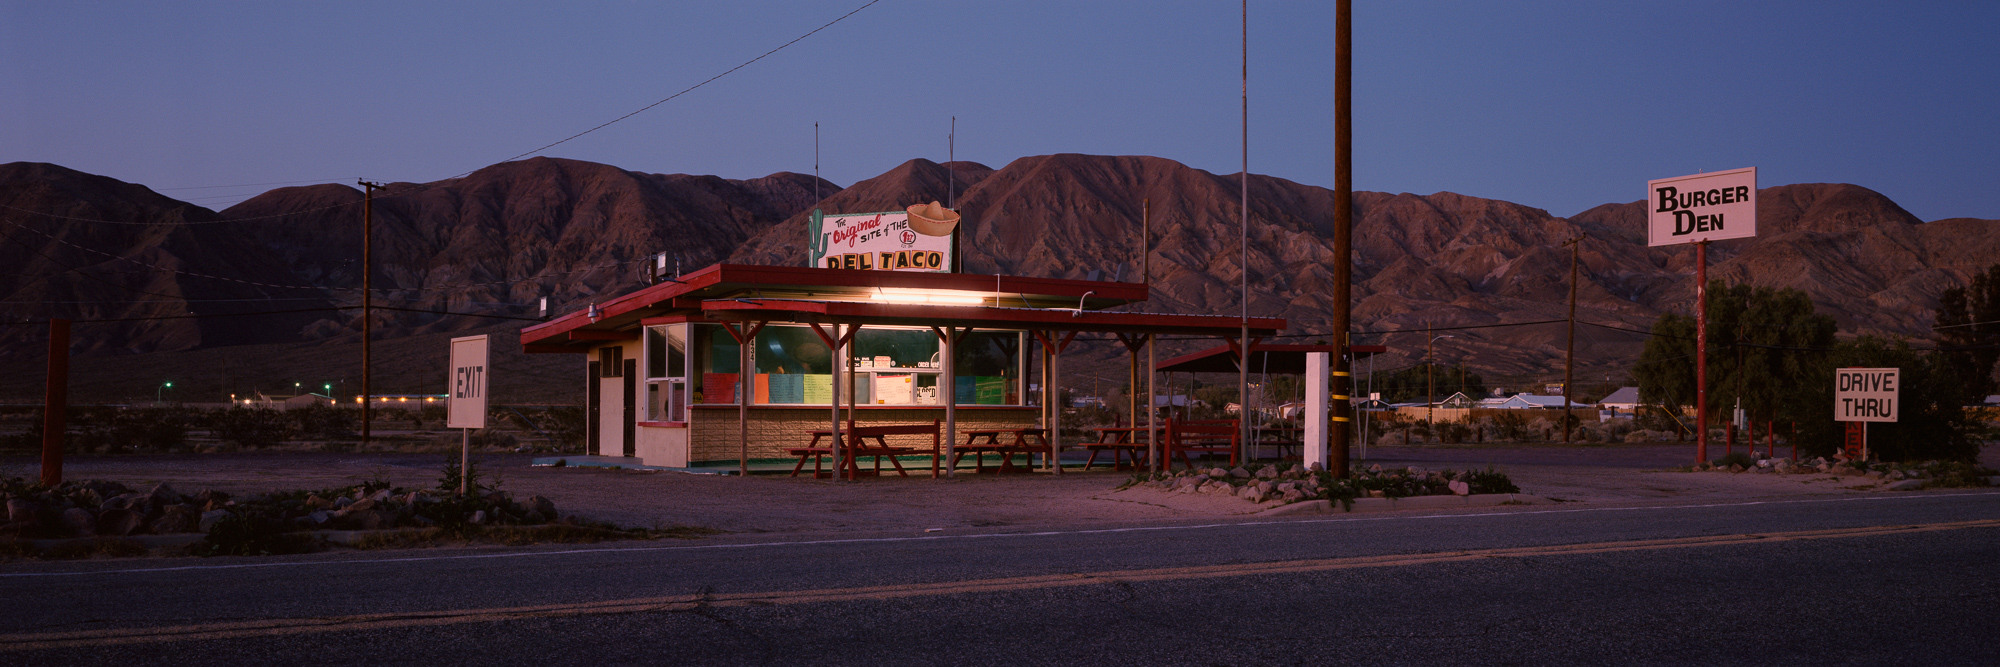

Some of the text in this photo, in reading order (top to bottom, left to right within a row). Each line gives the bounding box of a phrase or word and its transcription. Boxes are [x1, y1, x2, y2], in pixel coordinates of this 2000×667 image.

[1656, 186, 1748, 212] BURGER
[860, 229, 882, 242] SITE
[890, 219, 908, 230] THE
[1672, 210, 1724, 236] DEN
[827, 252, 941, 270] DEL TACO
[456, 366, 482, 398] EXIT
[1840, 373, 1895, 392] DRIVE
[1842, 398, 1891, 417] THRU
